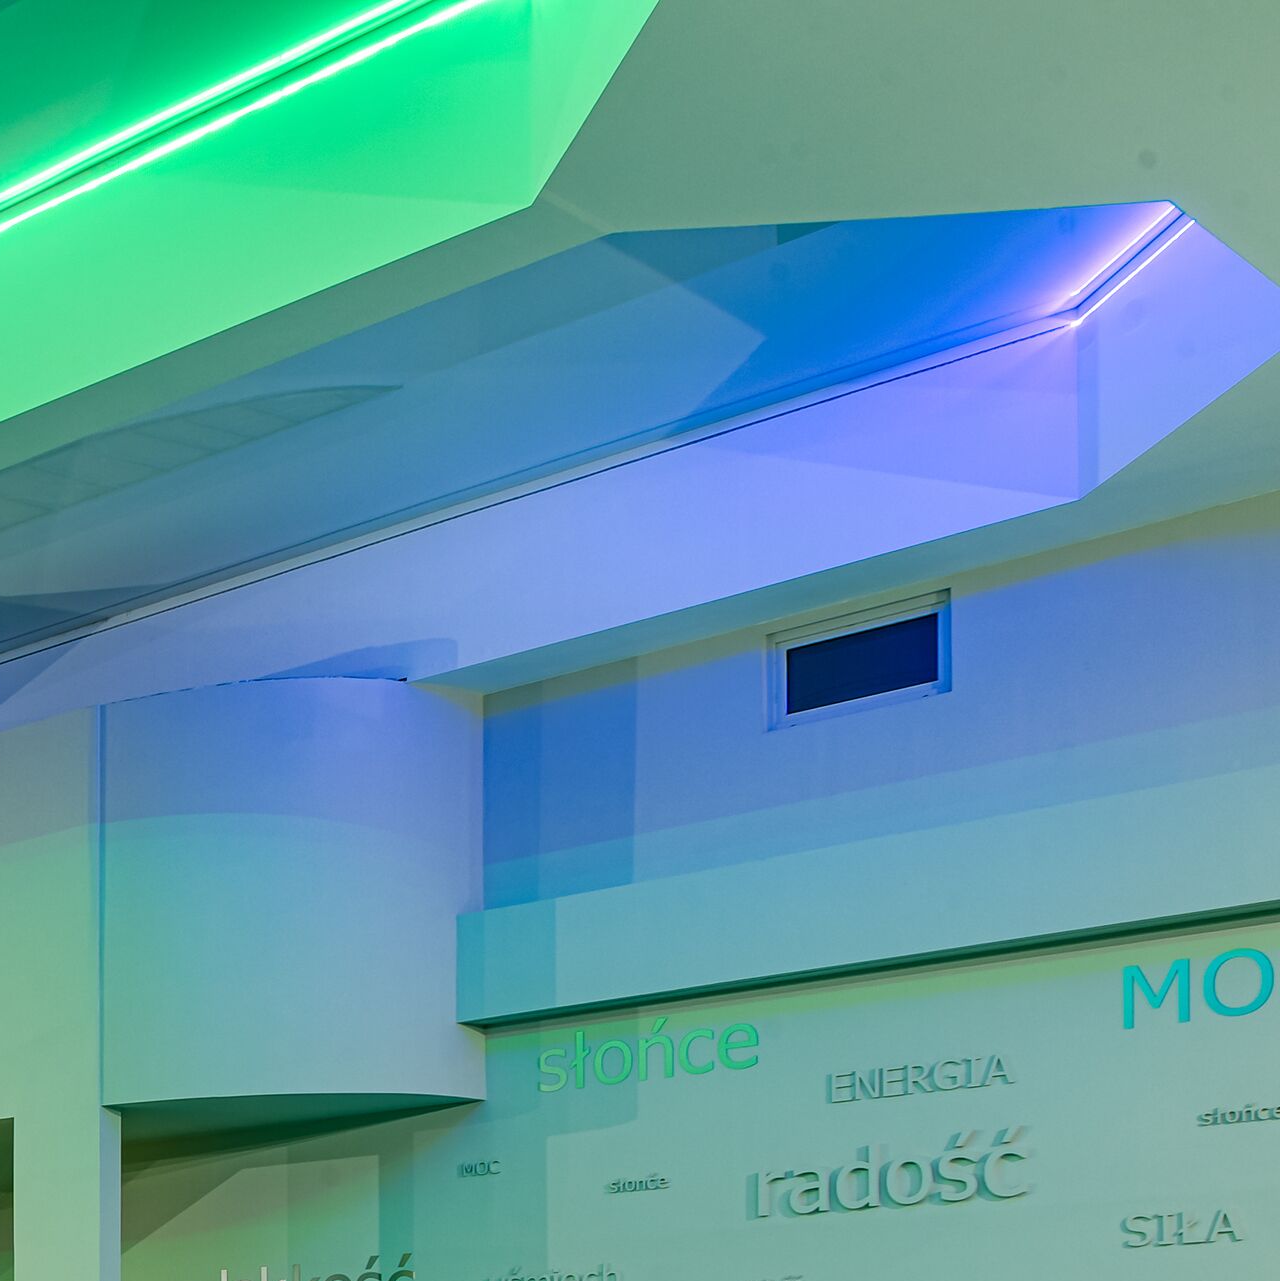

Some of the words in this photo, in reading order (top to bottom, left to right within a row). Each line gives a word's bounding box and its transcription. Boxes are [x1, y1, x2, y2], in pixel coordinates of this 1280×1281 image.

[537, 1016, 759, 1093] słońce
[827, 1054, 1015, 1104] ENERGIA
[458, 1160, 502, 1177] MOC
[747, 1125, 1030, 1220] radość
[1120, 1209, 1244, 1249] SIŁA
